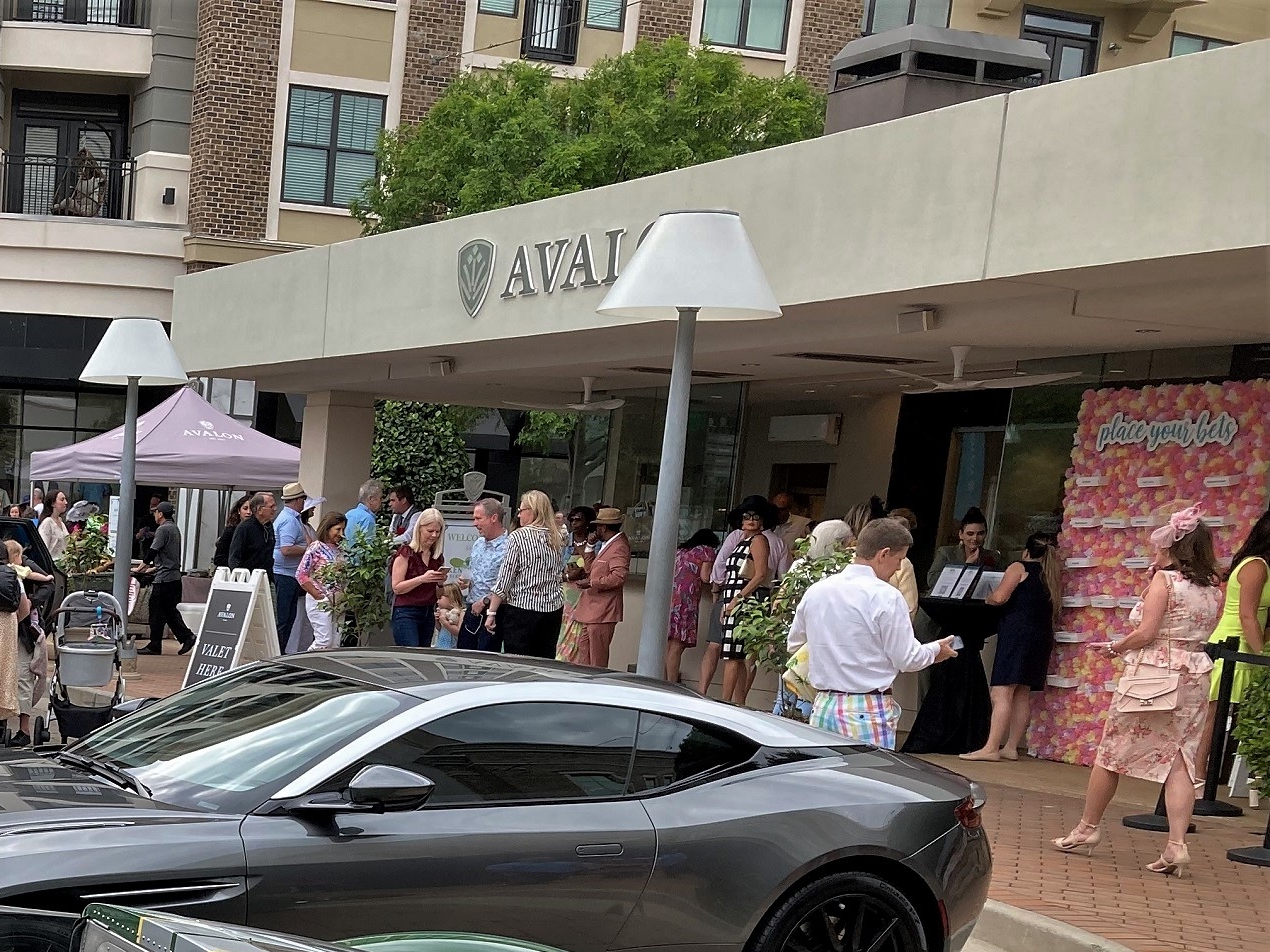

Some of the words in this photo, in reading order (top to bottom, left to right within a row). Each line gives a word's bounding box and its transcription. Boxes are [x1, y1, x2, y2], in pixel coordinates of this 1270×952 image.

[500, 221, 655, 299] AVAL
[183, 429, 245, 441] AVALON
[1097, 415, 1146, 448] place
[1149, 420, 1193, 448] your
[1196, 413, 1234, 443] bets
[448, 533, 479, 542] WELCO
[202, 643, 233, 659] VALET
[196, 663, 224, 677] HERE
